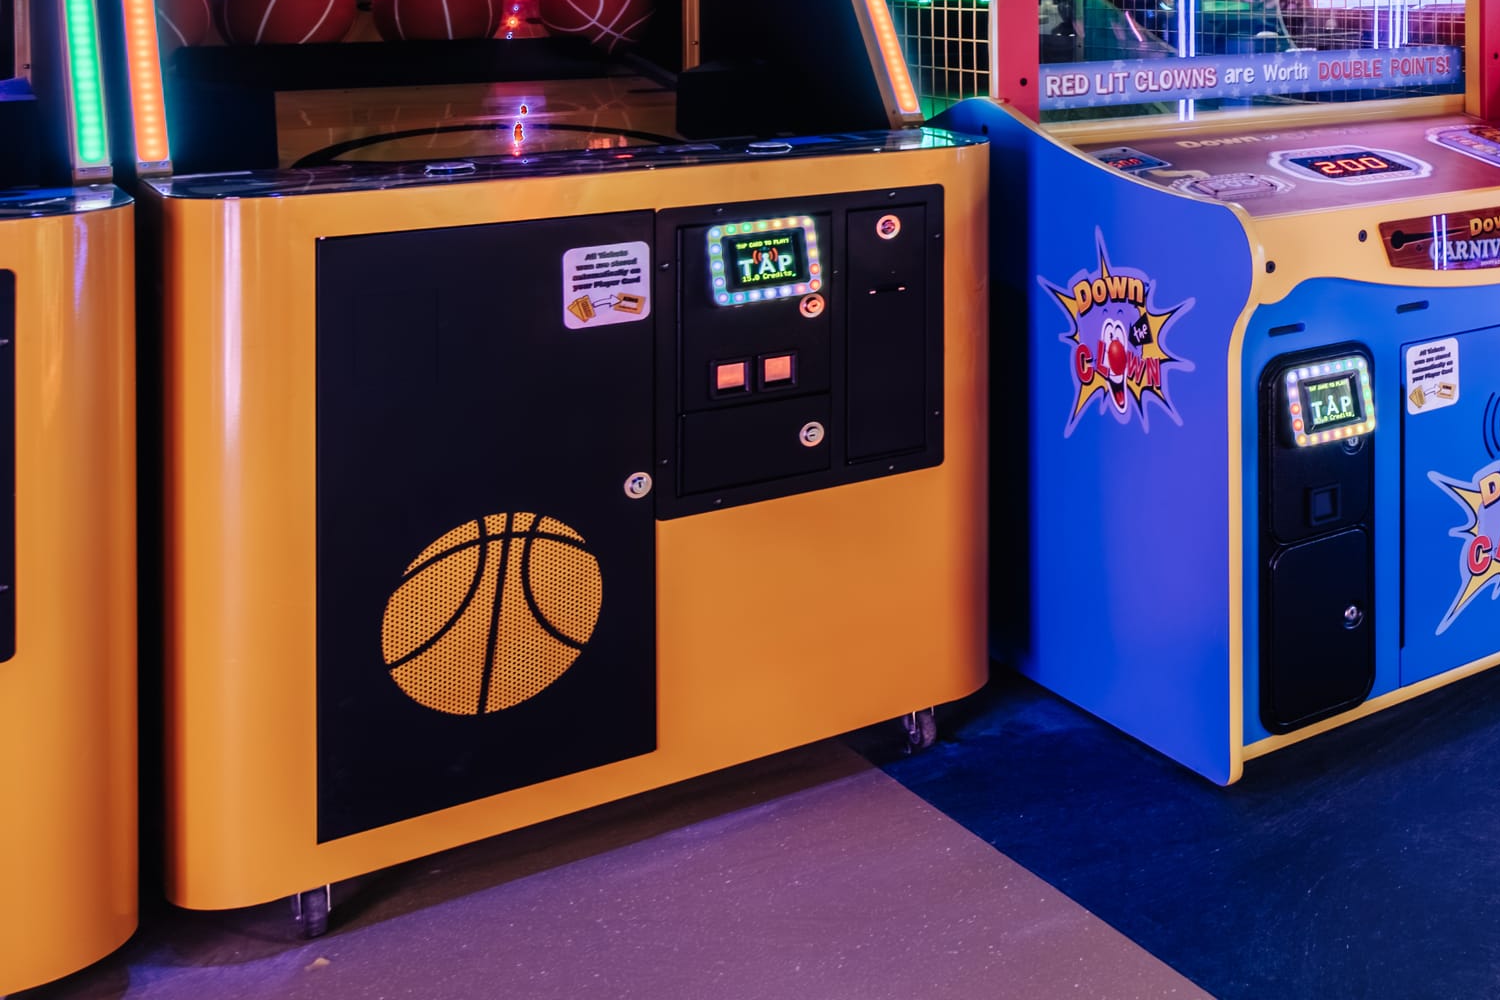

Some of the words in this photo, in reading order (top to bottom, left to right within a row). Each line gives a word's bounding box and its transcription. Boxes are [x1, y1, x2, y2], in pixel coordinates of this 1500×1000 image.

[1046, 74, 1089, 97] RED
[1095, 71, 1129, 95] LIT
[1134, 66, 1217, 92] CLOWNS
[1224, 66, 1256, 85] are
[1263, 61, 1309, 82] Worth
[1317, 58, 1383, 82] DOUBLE
[1390, 55, 1451, 78] POINTS!
[1315, 157, 1388, 174] 200
[738, 251, 793, 277] TAP
[1073, 275, 1145, 316] Down
[1133, 324, 1148, 343] the
[1310, 394, 1351, 420] TAP
